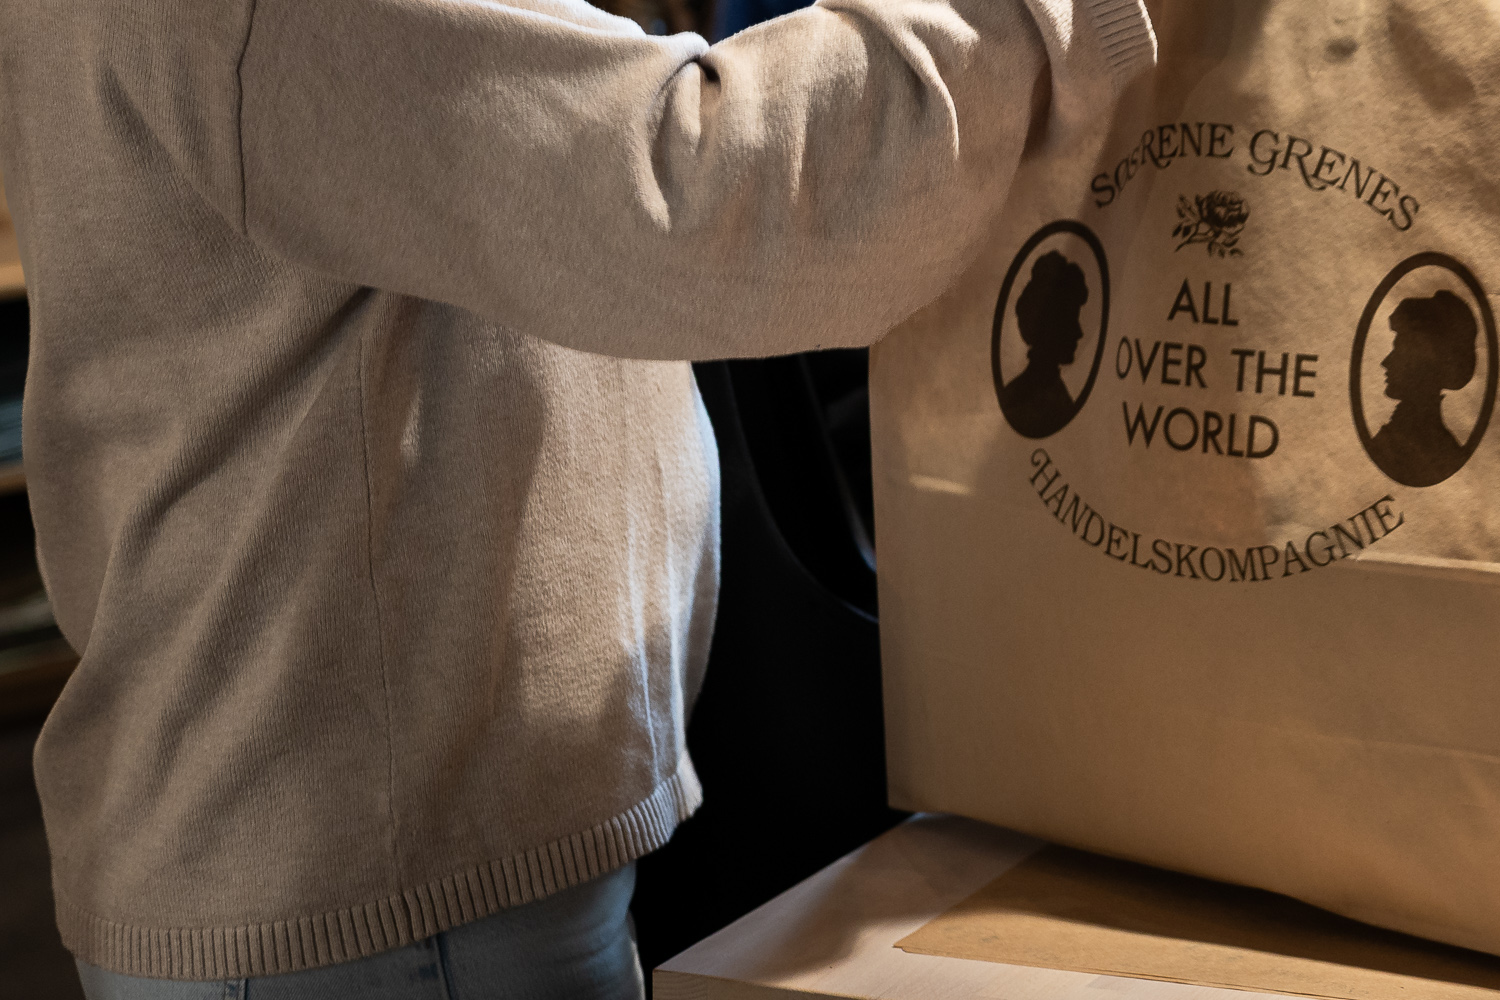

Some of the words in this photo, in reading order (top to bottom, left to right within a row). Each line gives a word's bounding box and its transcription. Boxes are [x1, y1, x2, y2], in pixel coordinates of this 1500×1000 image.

[1246, 129, 1421, 232] GRENES
[1166, 277, 1240, 327] ALL
[1115, 335, 1208, 389] OVER
[1230, 347, 1319, 398] THE
[1121, 400, 1281, 460] WORLD
[1028, 447, 1406, 583] HANDELSKOMPAGNIE
